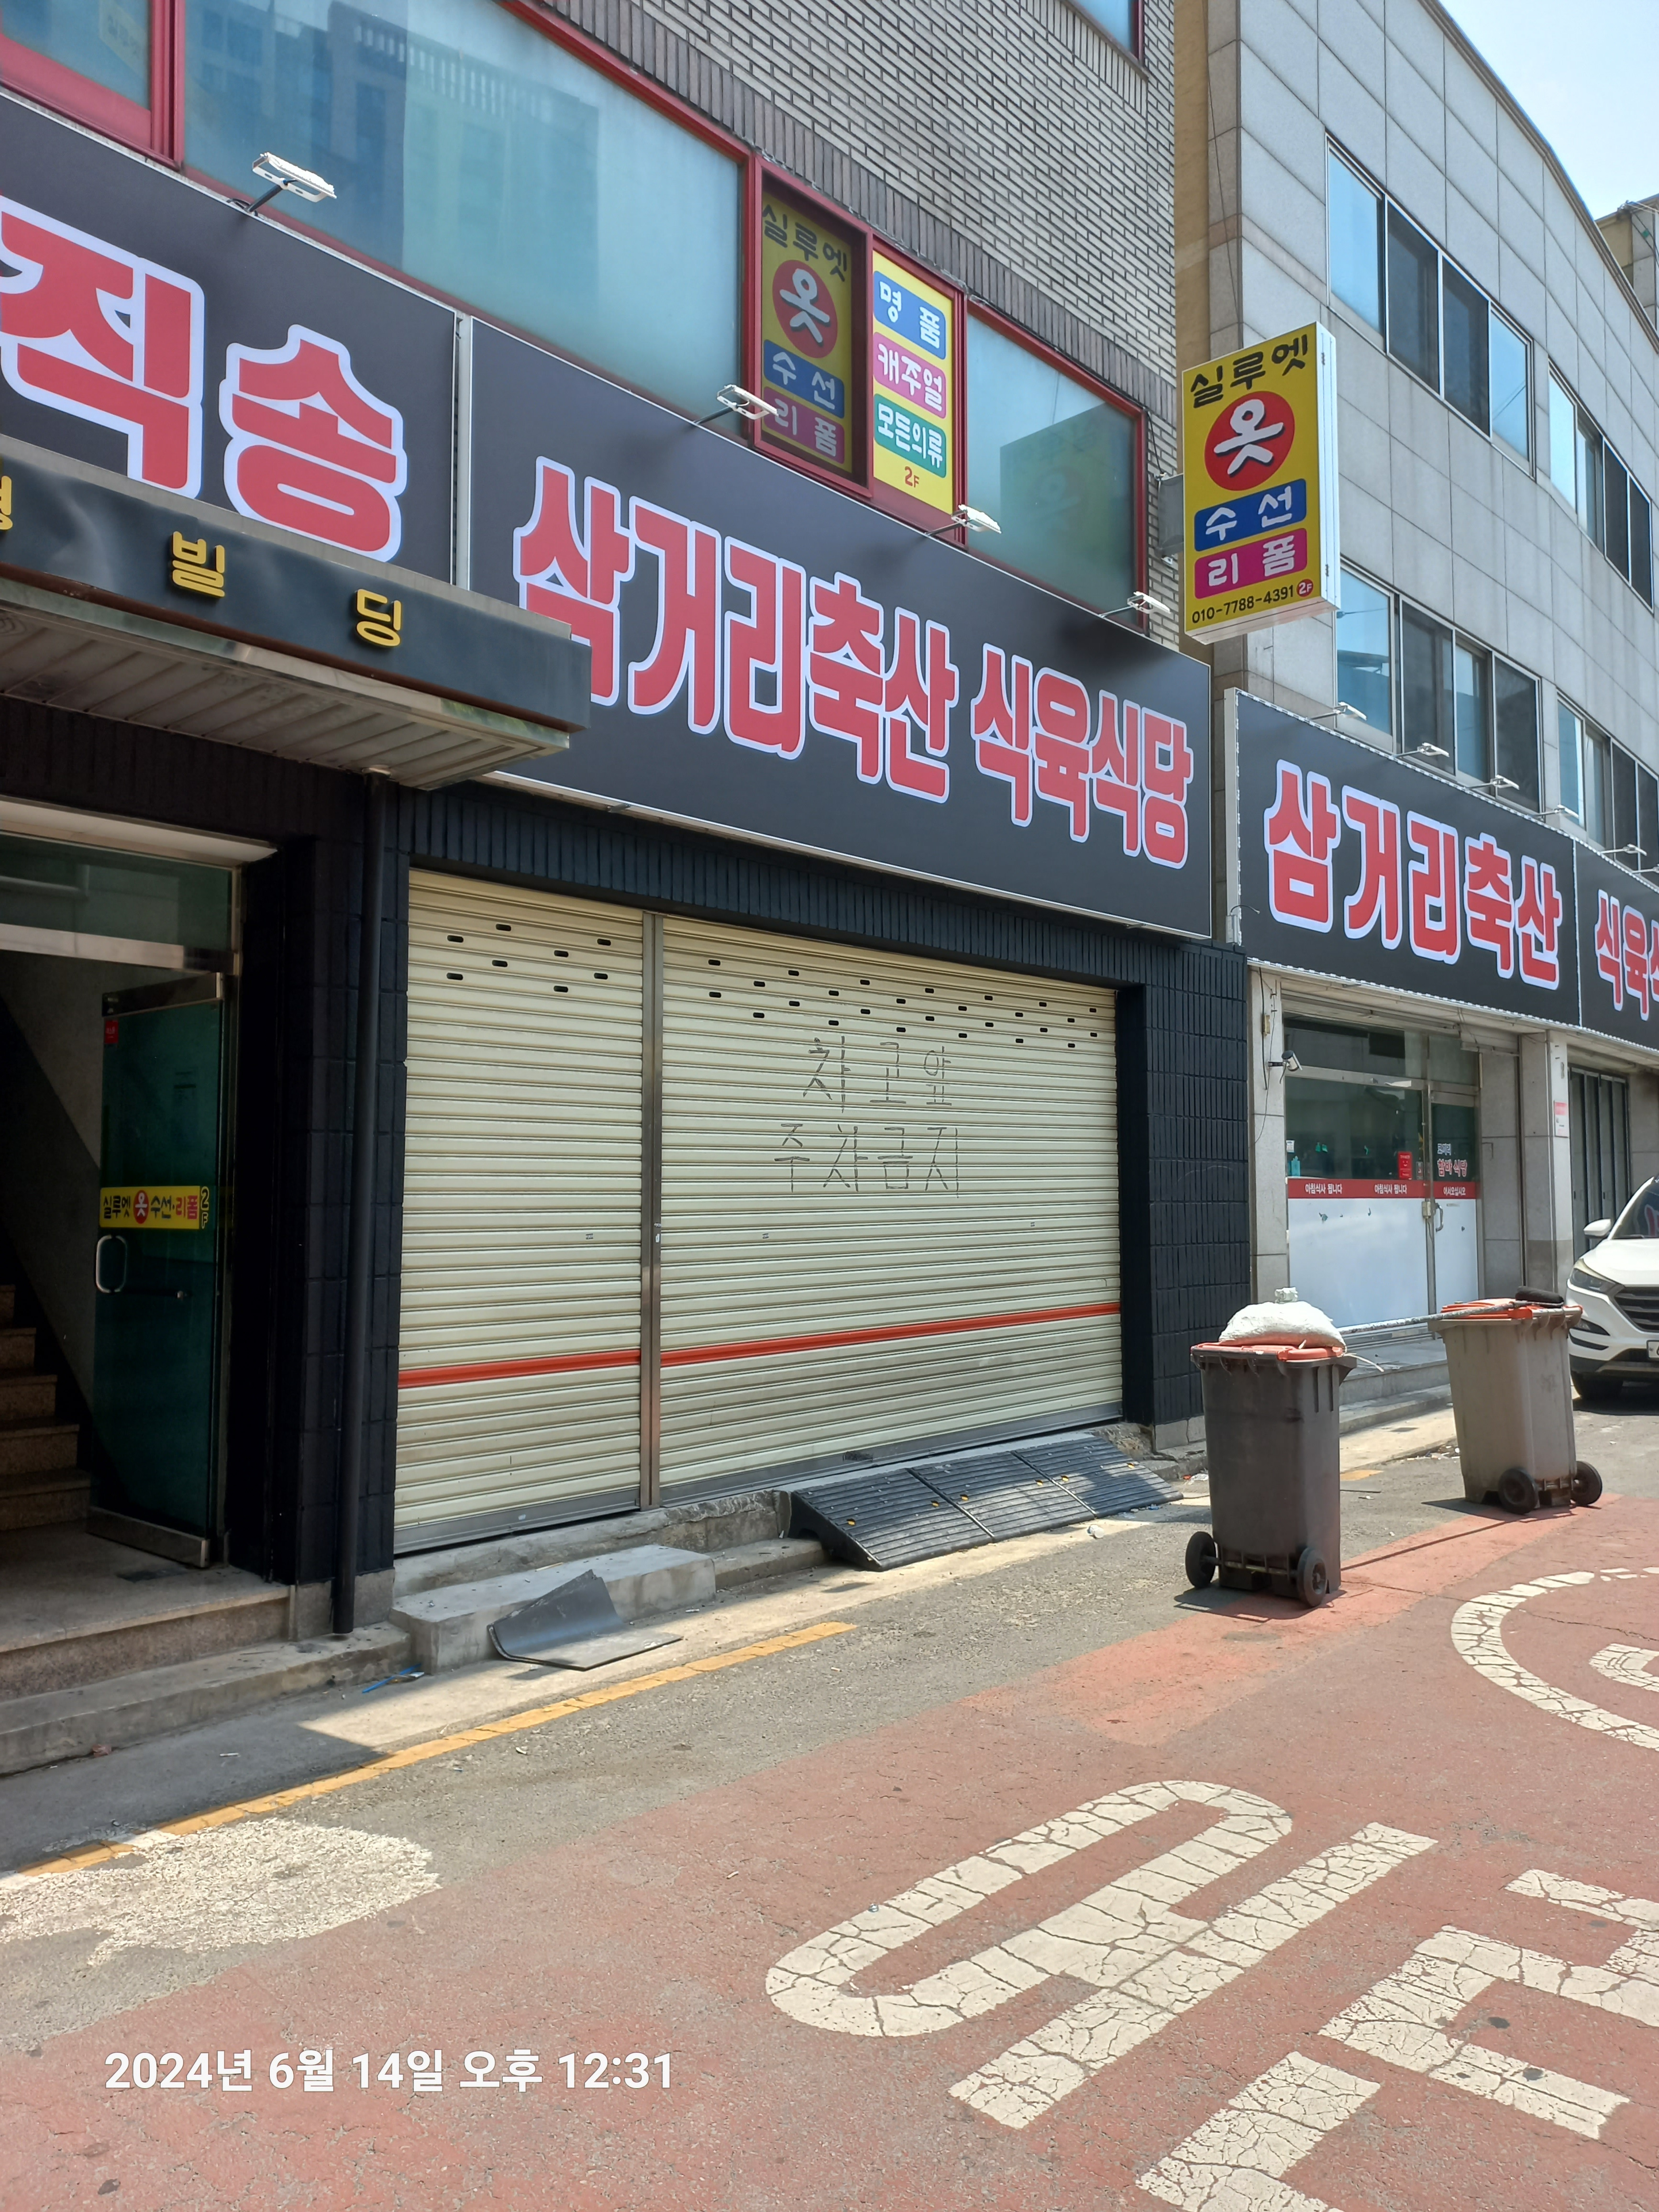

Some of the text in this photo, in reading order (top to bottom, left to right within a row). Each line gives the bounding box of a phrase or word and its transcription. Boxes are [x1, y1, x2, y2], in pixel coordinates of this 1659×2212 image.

[763, 204, 847, 282] 실루엣
[779, 268, 831, 345] 옷
[879, 281, 940, 349] 명품
[773, 351, 835, 410] 수선
[877, 343, 942, 411] 캐주얼
[1190, 333, 1308, 409] 실루엣
[774, 398, 837, 457] 리폼
[878, 403, 943, 468] 모든의류
[1214, 398, 1285, 477] 옷
[904, 466, 920, 488] 2F
[1205, 486, 1293, 541] 수선
[1208, 534, 1295, 587] 리폼
[1192, 582, 1312, 624] 010-7788-4391 2F
[971, 643, 1194, 869] 식육식당
[1263, 759, 1563, 991] 삼거리축산
[774, 1124, 960, 1199] 주차금지
[1305, 1183, 1343, 1194] 아침식사 됩니다
[1374, 1183, 1407, 1194] 아침식사 됩니다
[1443, 1186, 1466, 1196] 어서오십시오
[1453, 1159, 1468, 1177] 식당
[103, 1195, 131, 1219] 실루엣
[135, 1192, 148, 1217] 옷
